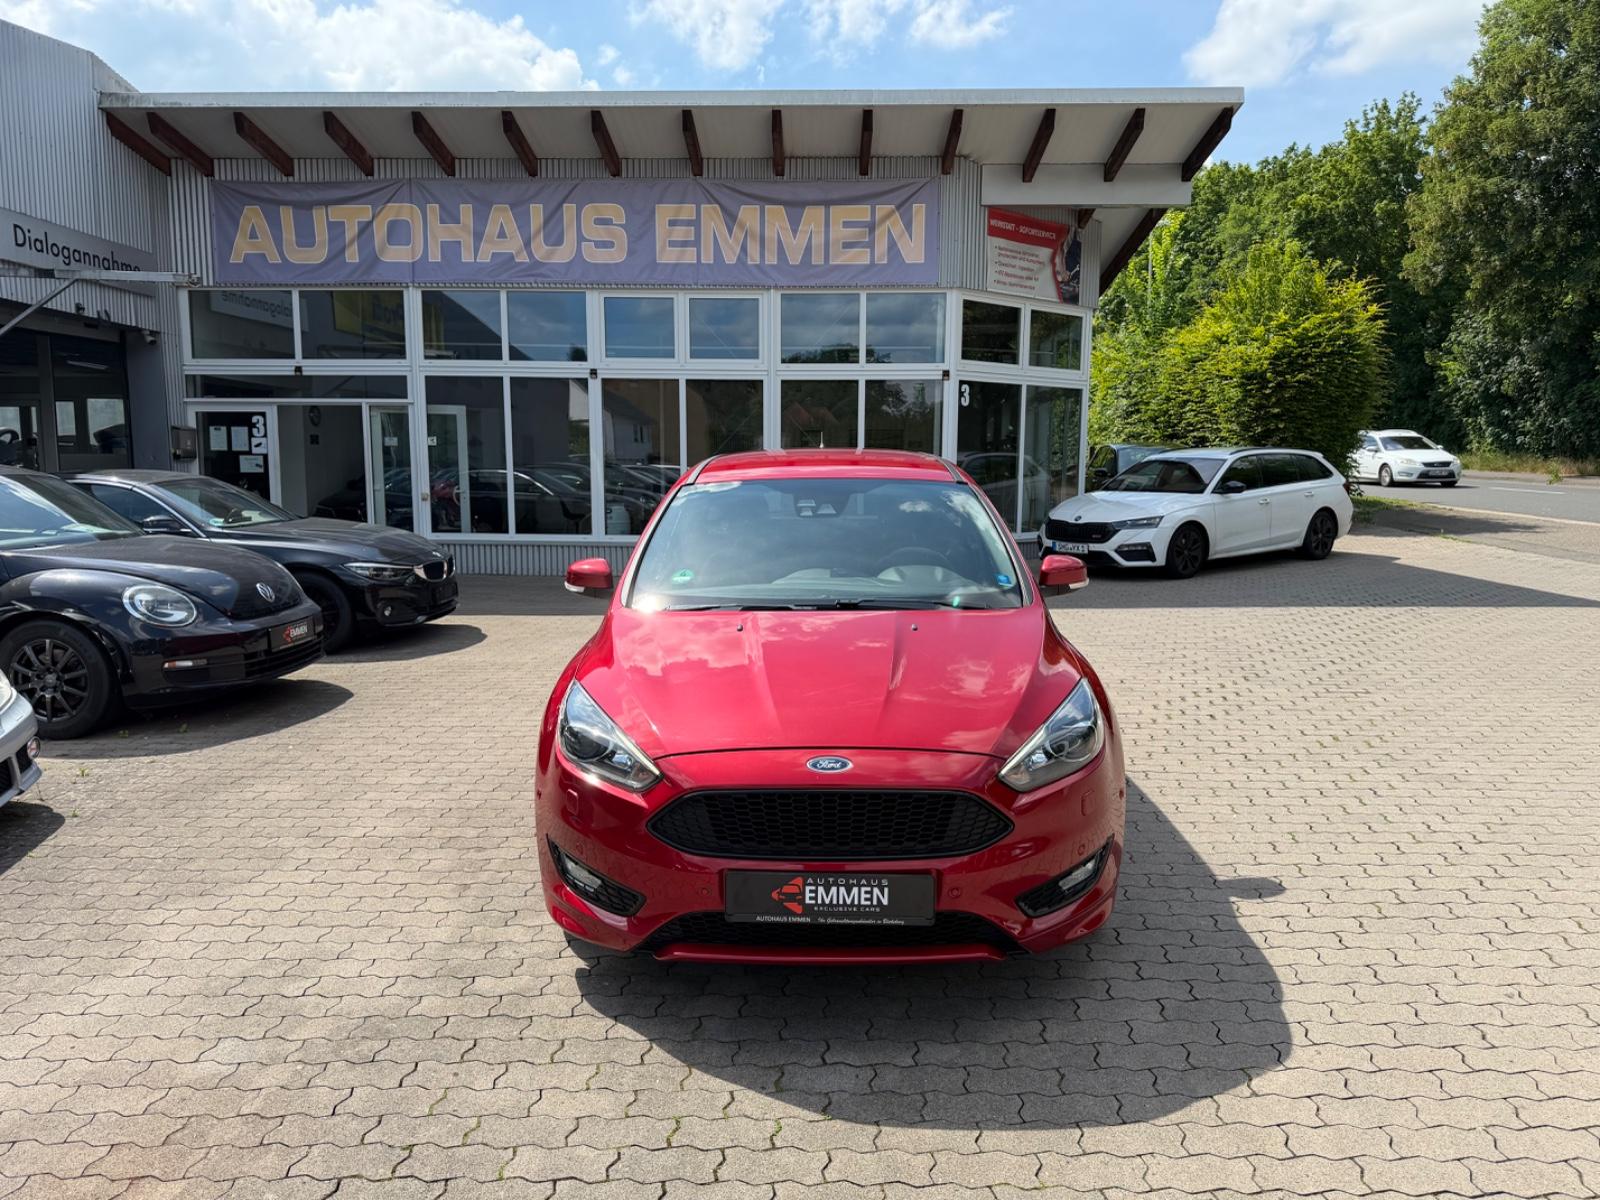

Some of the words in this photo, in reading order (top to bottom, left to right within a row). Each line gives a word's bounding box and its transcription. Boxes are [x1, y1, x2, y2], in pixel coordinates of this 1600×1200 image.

[229, 203, 628, 264] AUTOHAUS
[655, 203, 926, 265] EMMEN
[960, 384, 970, 407] 3
[251, 415, 265, 437] 3
[816, 759, 842, 769] Ford
[806, 877, 889, 886] AUTOHAUS
[804, 885, 889, 906] EMMEN
[756, 915, 788, 923] AUTOHAUS
